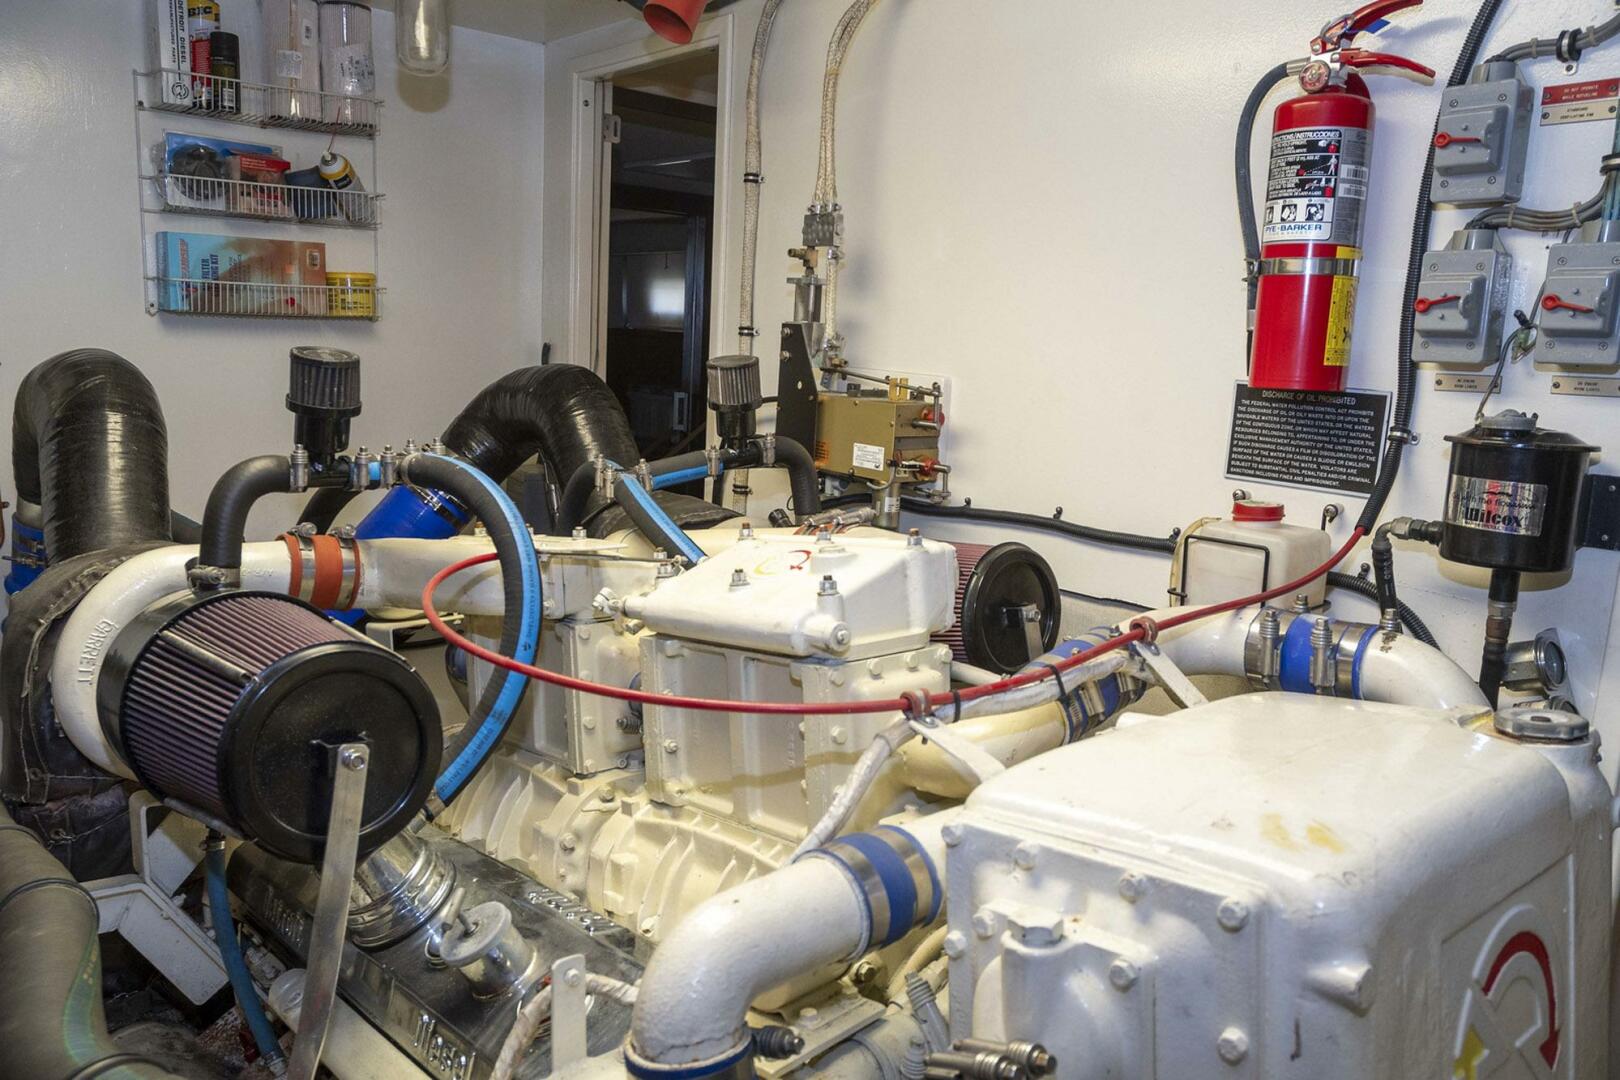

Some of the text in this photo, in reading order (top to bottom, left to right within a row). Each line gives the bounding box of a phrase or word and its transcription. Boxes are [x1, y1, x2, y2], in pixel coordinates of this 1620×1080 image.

[1262, 390, 1295, 400] DISCHARGE
[1259, 436, 1290, 444] MANAGEMENT
[1296, 433, 1330, 441] APPERTAINING
[1258, 464, 1288, 472] SUBSTANTIAL
[1464, 507, 1523, 527] Wilcox
[77, 618, 119, 686] GARRETT
